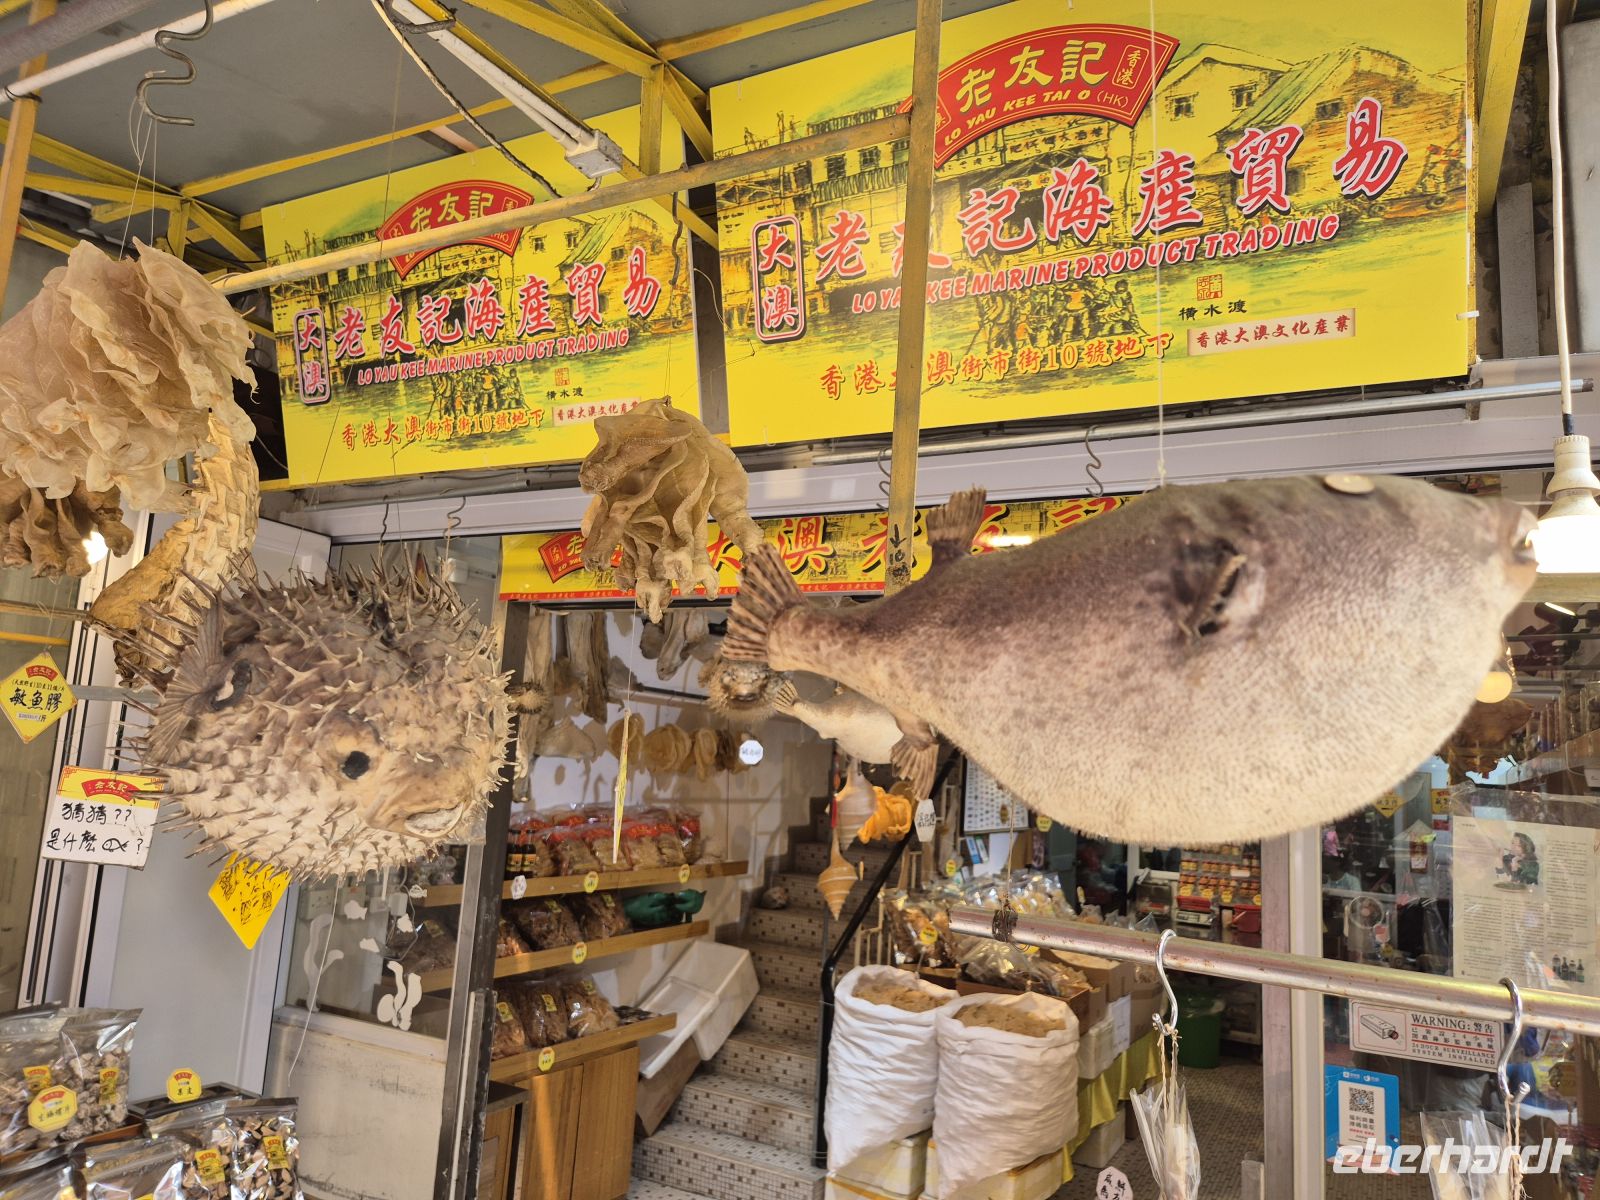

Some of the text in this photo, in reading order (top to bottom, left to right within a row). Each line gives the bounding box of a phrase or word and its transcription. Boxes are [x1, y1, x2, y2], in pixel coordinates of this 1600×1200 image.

[956, 39, 1109, 114] 老友記
[1115, 49, 1142, 87] 香港
[944, 128, 961, 146] LO
[966, 105, 996, 129] YAU
[1003, 94, 1037, 112] KEE
[1043, 89, 1072, 103] TAI
[1077, 89, 1091, 100] O
[1097, 91, 1129, 109] (HK)
[758, 223, 799, 330] 大澳
[852, 293, 877, 314] LO
[971, 259, 1070, 295] MARINE
[1073, 236, 1201, 280] PRODUCT
[1204, 213, 1341, 258] TRADING
[299, 315, 327, 393] 大澳
[357, 328, 630, 386] LO YAU KEE MARINE PRODUCT TRADING
[1411, 1014, 1470, 1030] WARNING:
[1448, 1053, 1496, 1065] INSTALLED
